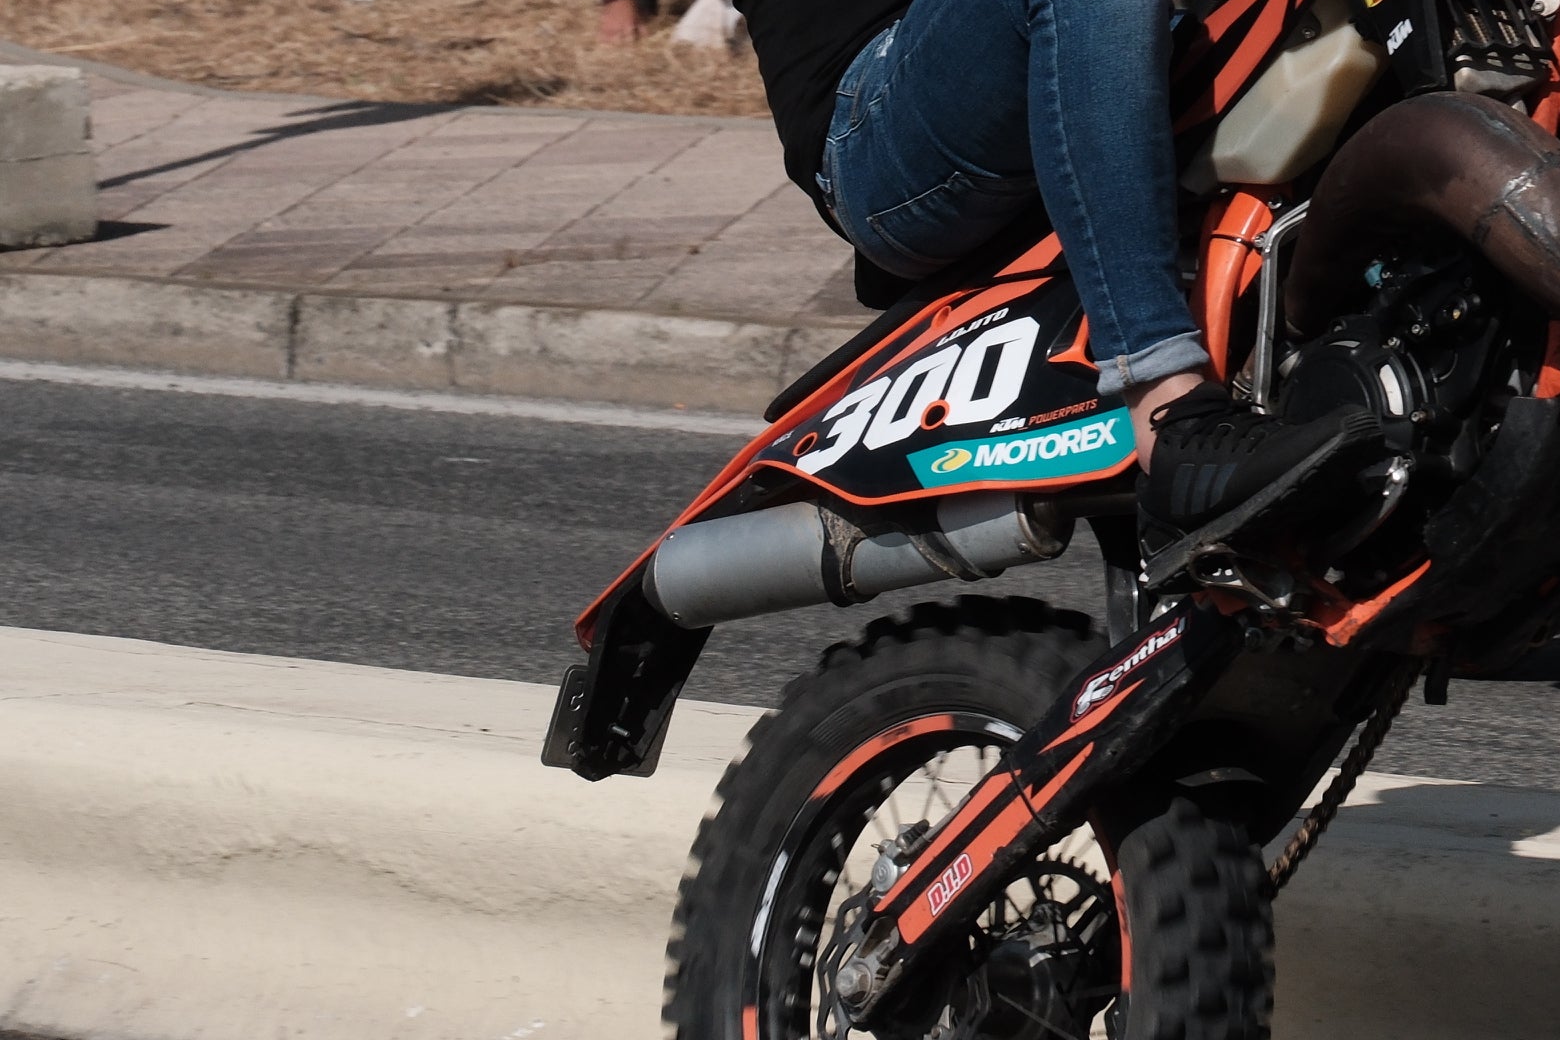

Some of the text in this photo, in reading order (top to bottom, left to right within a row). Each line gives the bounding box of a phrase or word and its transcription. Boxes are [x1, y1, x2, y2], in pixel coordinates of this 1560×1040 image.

[1387, 18, 1414, 56] KTM
[936, 308, 1010, 348] LOJITO
[796, 316, 1041, 475] 300
[989, 399, 1099, 434] KTM POWERPARTS
[973, 420, 1118, 468] MOTOREX
[1074, 616, 1186, 718] Renthal
[928, 854, 972, 914] D.I.D
